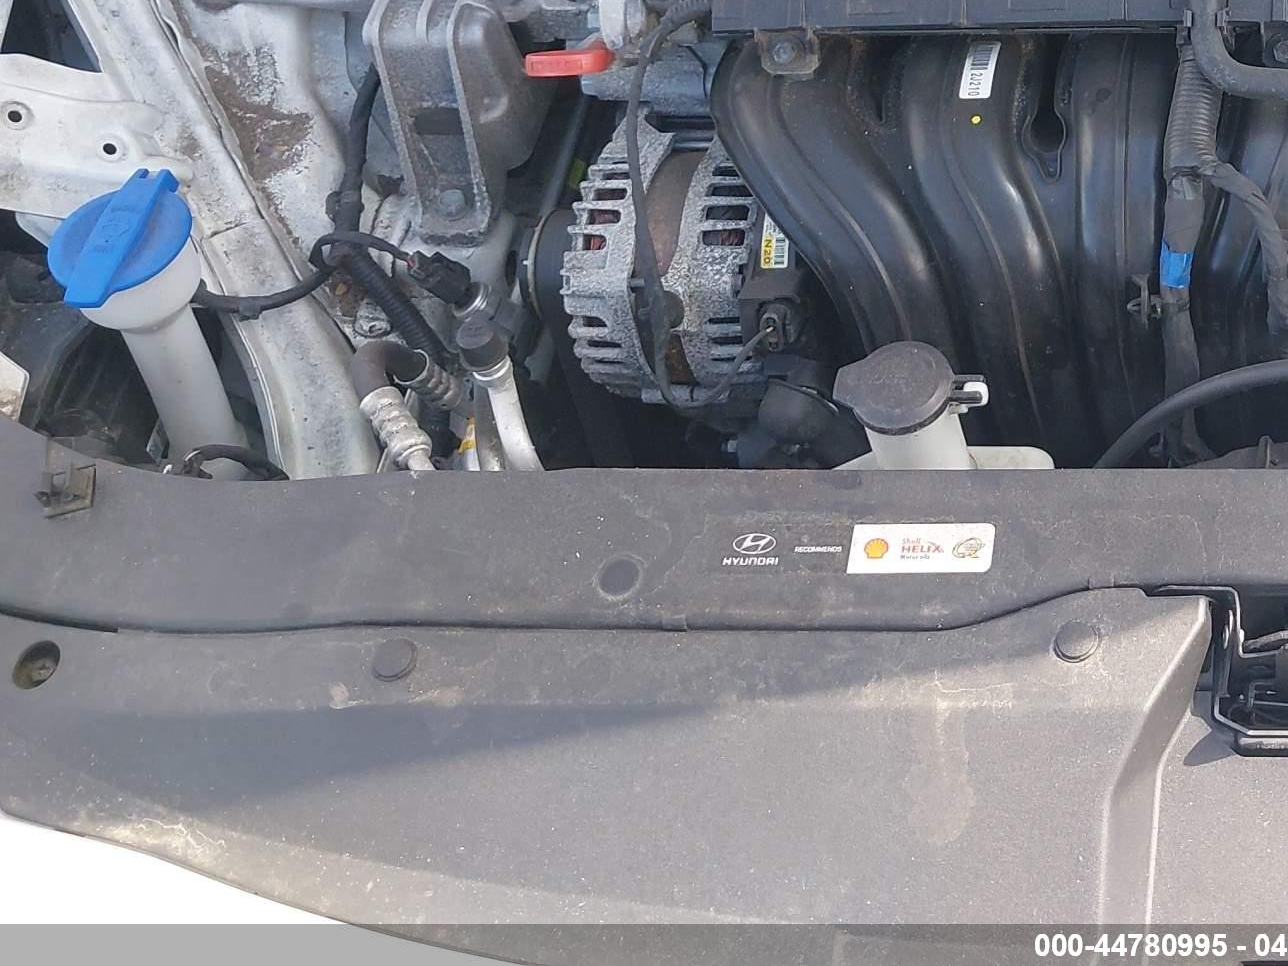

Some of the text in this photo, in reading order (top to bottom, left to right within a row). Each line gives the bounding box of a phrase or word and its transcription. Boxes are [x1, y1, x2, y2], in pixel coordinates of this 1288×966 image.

[967, 72, 983, 97] 2J210
[763, 239, 772, 265] N20
[901, 544, 941, 554] HELIX
[902, 537, 922, 545] Shell
[722, 545, 843, 566] HYUNDAI RECOMMENDS
